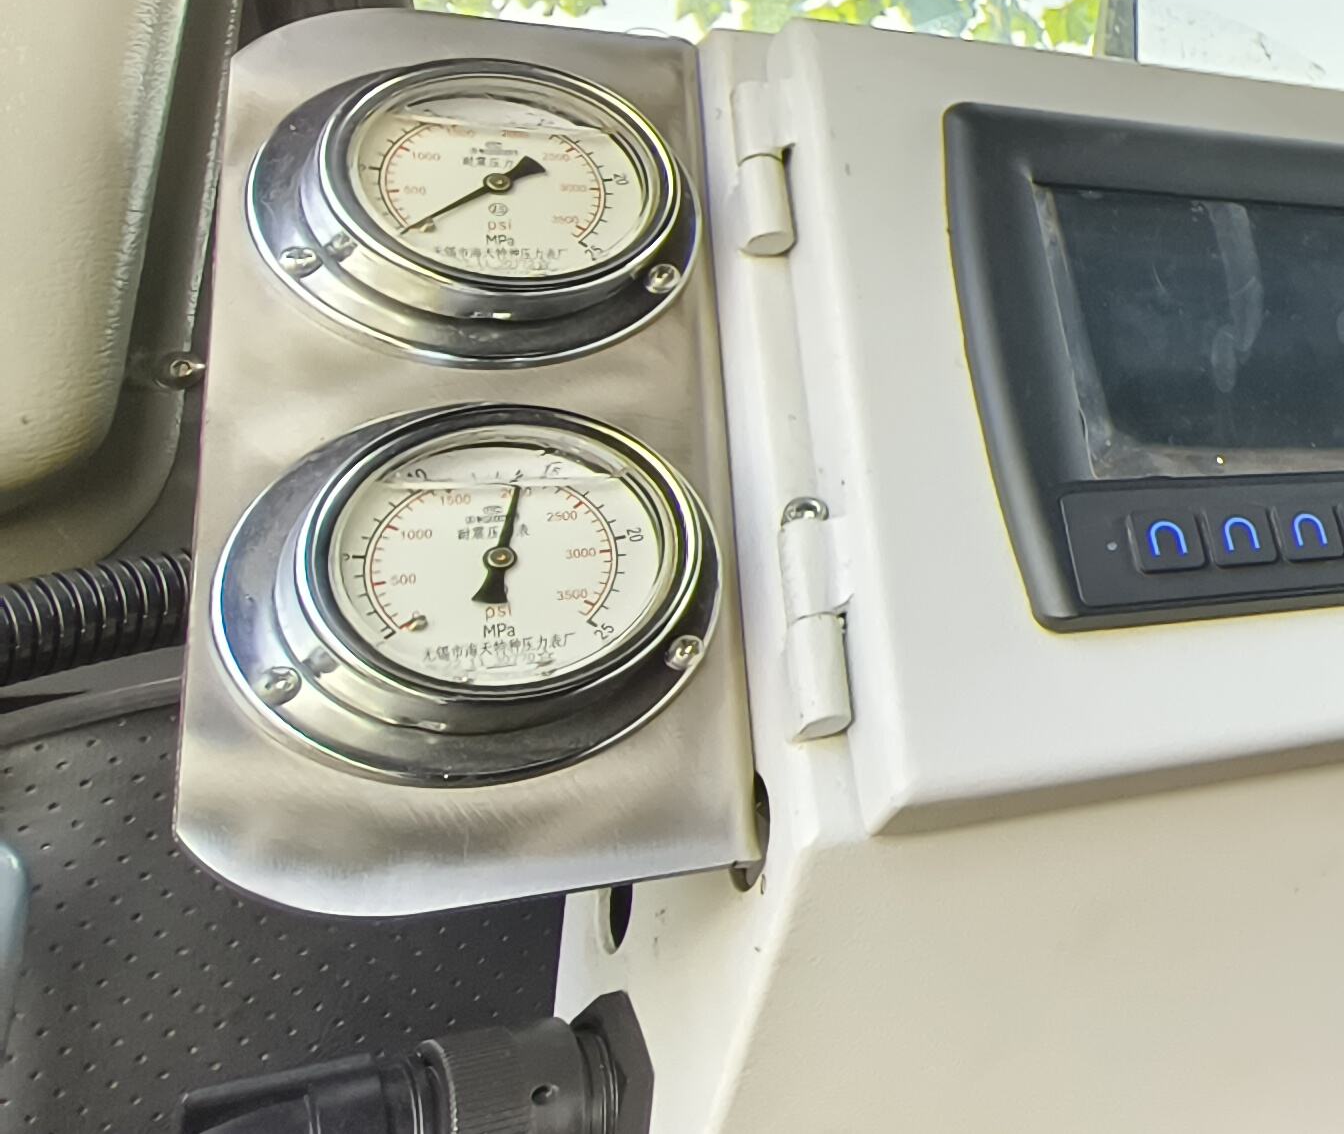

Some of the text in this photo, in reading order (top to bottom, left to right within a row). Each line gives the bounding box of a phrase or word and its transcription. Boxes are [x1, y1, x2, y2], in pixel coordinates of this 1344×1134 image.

[440, 494, 472, 506] 1500
[401, 528, 433, 540] 1000
[626, 527, 644, 542] 20
[390, 573, 417, 586] 500
[485, 604, 512, 621] psi
[483, 622, 516, 638] MPa
[593, 622, 615, 641] 25
